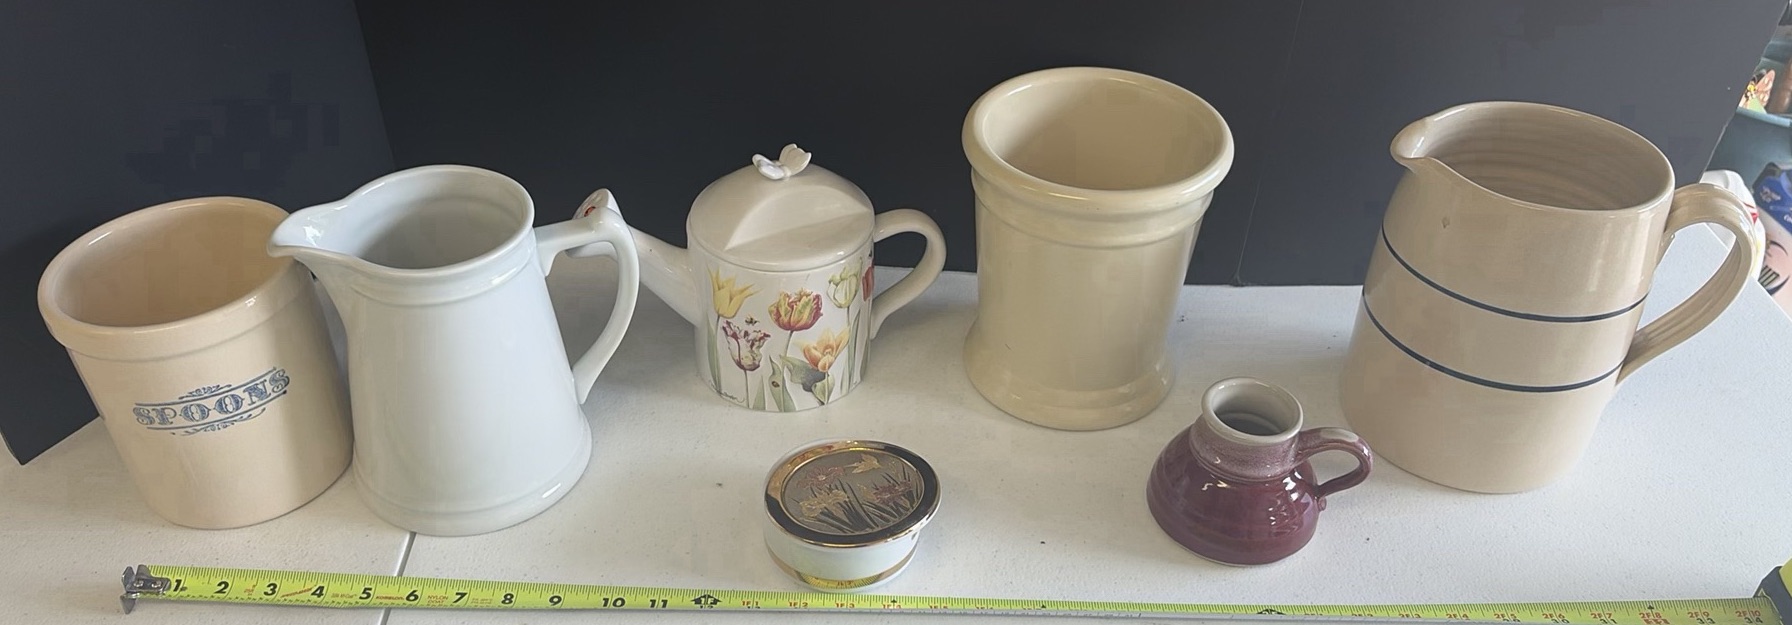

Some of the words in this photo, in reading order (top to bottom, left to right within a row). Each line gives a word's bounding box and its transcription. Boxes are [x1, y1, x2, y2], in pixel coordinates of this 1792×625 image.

[133, 369, 290, 426] SPOONS
[173, 579, 182, 592] 1
[214, 581, 229, 594] 2
[263, 582, 278, 596] 3
[311, 585, 325, 598] 4
[359, 587, 372, 600] 5
[405, 590, 419, 602] 6
[452, 592, 467, 603] 7
[501, 593, 514, 605] 8
[548, 595, 562, 606] 9
[602, 597, 625, 608] 10
[650, 599, 668, 609] 11
